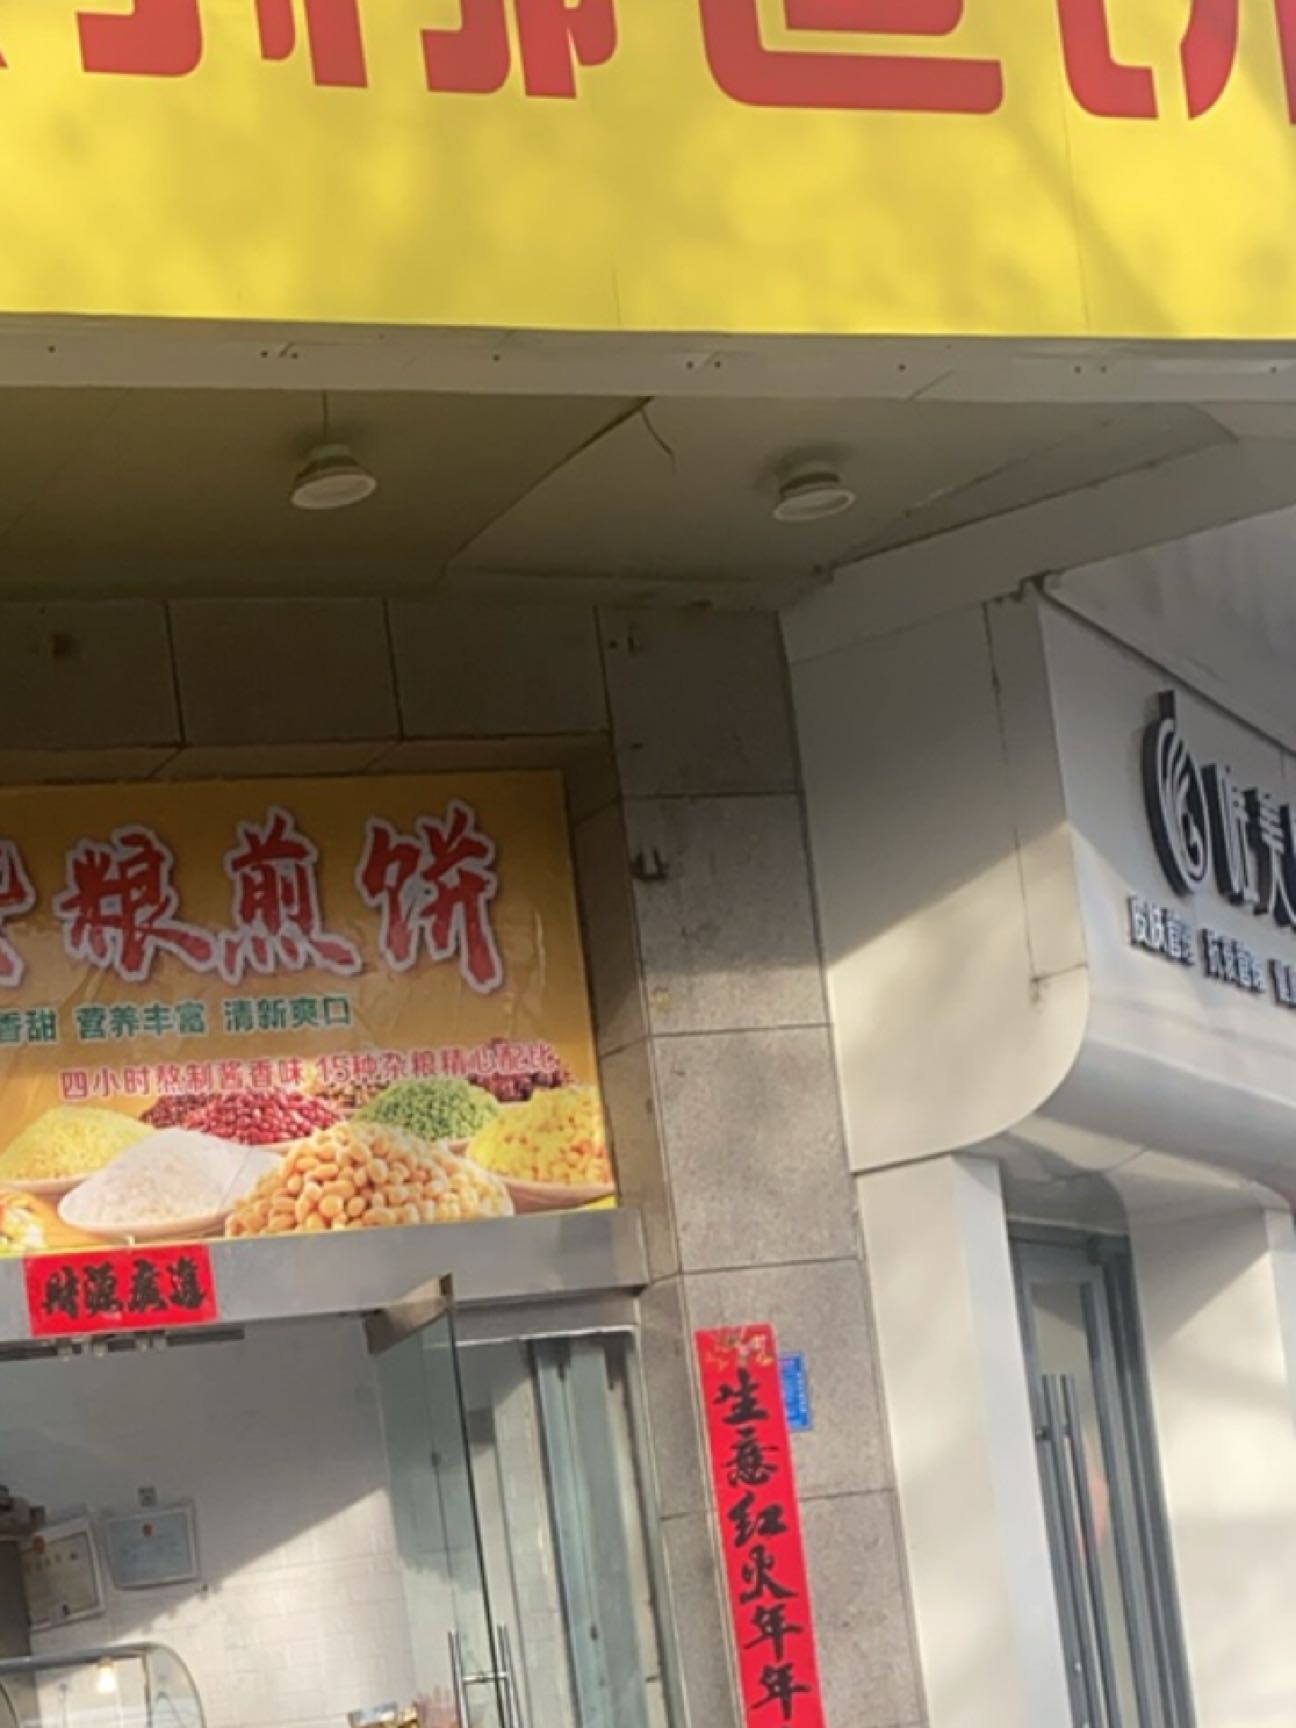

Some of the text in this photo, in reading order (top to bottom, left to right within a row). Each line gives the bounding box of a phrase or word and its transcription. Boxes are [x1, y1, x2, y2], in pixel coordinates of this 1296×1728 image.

[75, 1000, 207, 1042] 营养丰富
[223, 995, 353, 1034] 清新爽口
